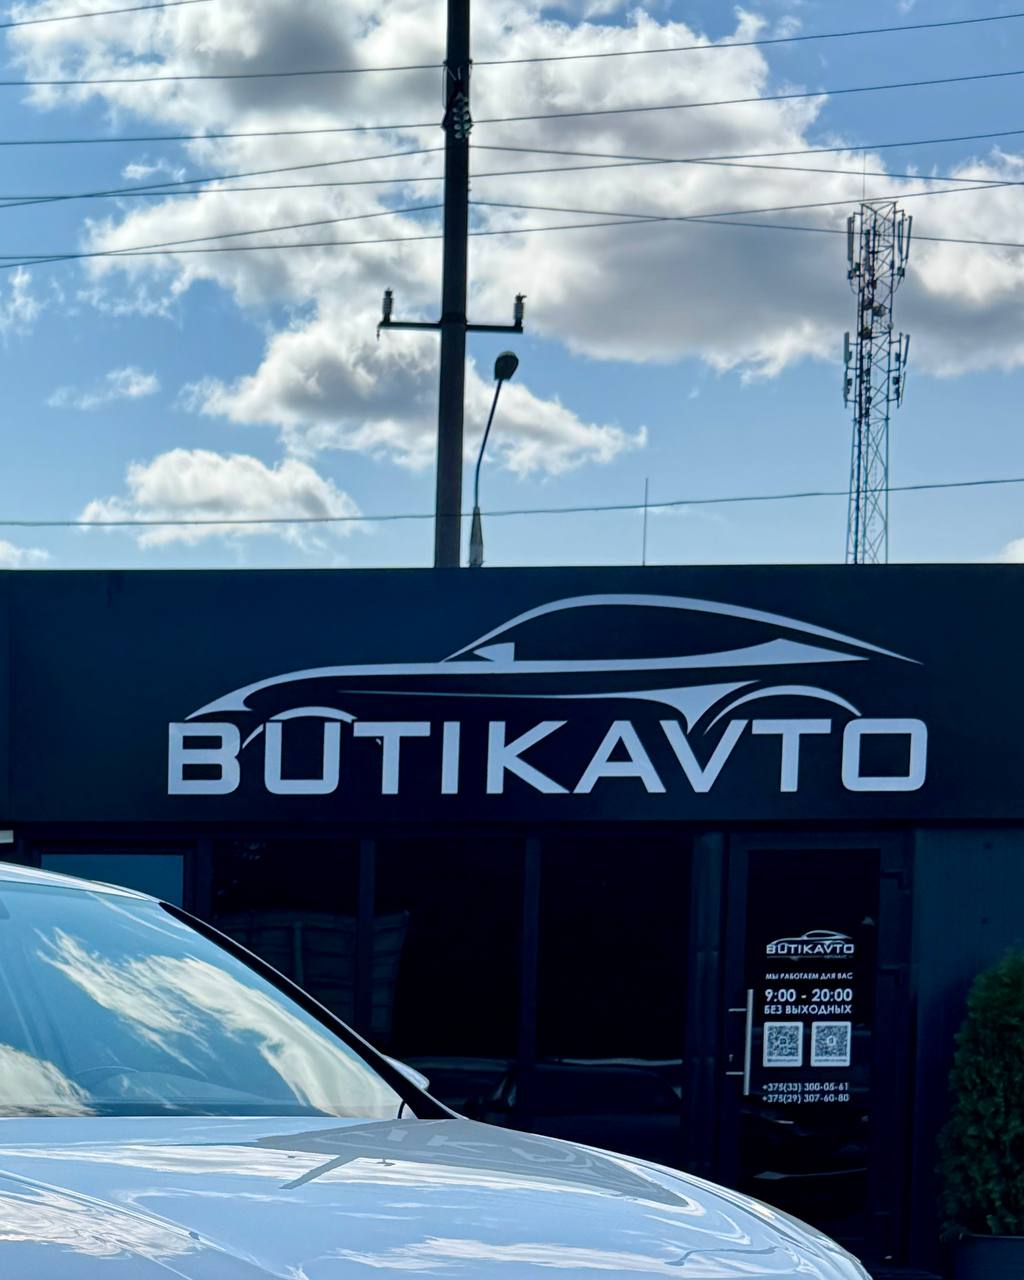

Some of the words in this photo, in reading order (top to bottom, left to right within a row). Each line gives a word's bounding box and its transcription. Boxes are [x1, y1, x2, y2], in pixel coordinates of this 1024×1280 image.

[167, 717, 928, 796] BUTIKAVTO
[766, 944, 855, 954] BUTIKAVTO
[837, 972, 853, 980] ВАС
[765, 989, 796, 1002] 9:00
[811, 989, 853, 1002] 20:00
[764, 1005, 783, 1015] БЕЗ
[785, 1004, 852, 1015] ВЫХОДНЫХ
[762, 1082, 802, 1093] +375(33)
[804, 1082, 849, 1091] 300-05-61
[762, 1093, 802, 1104] +375(29)
[803, 1093, 850, 1103] 307-60-80
